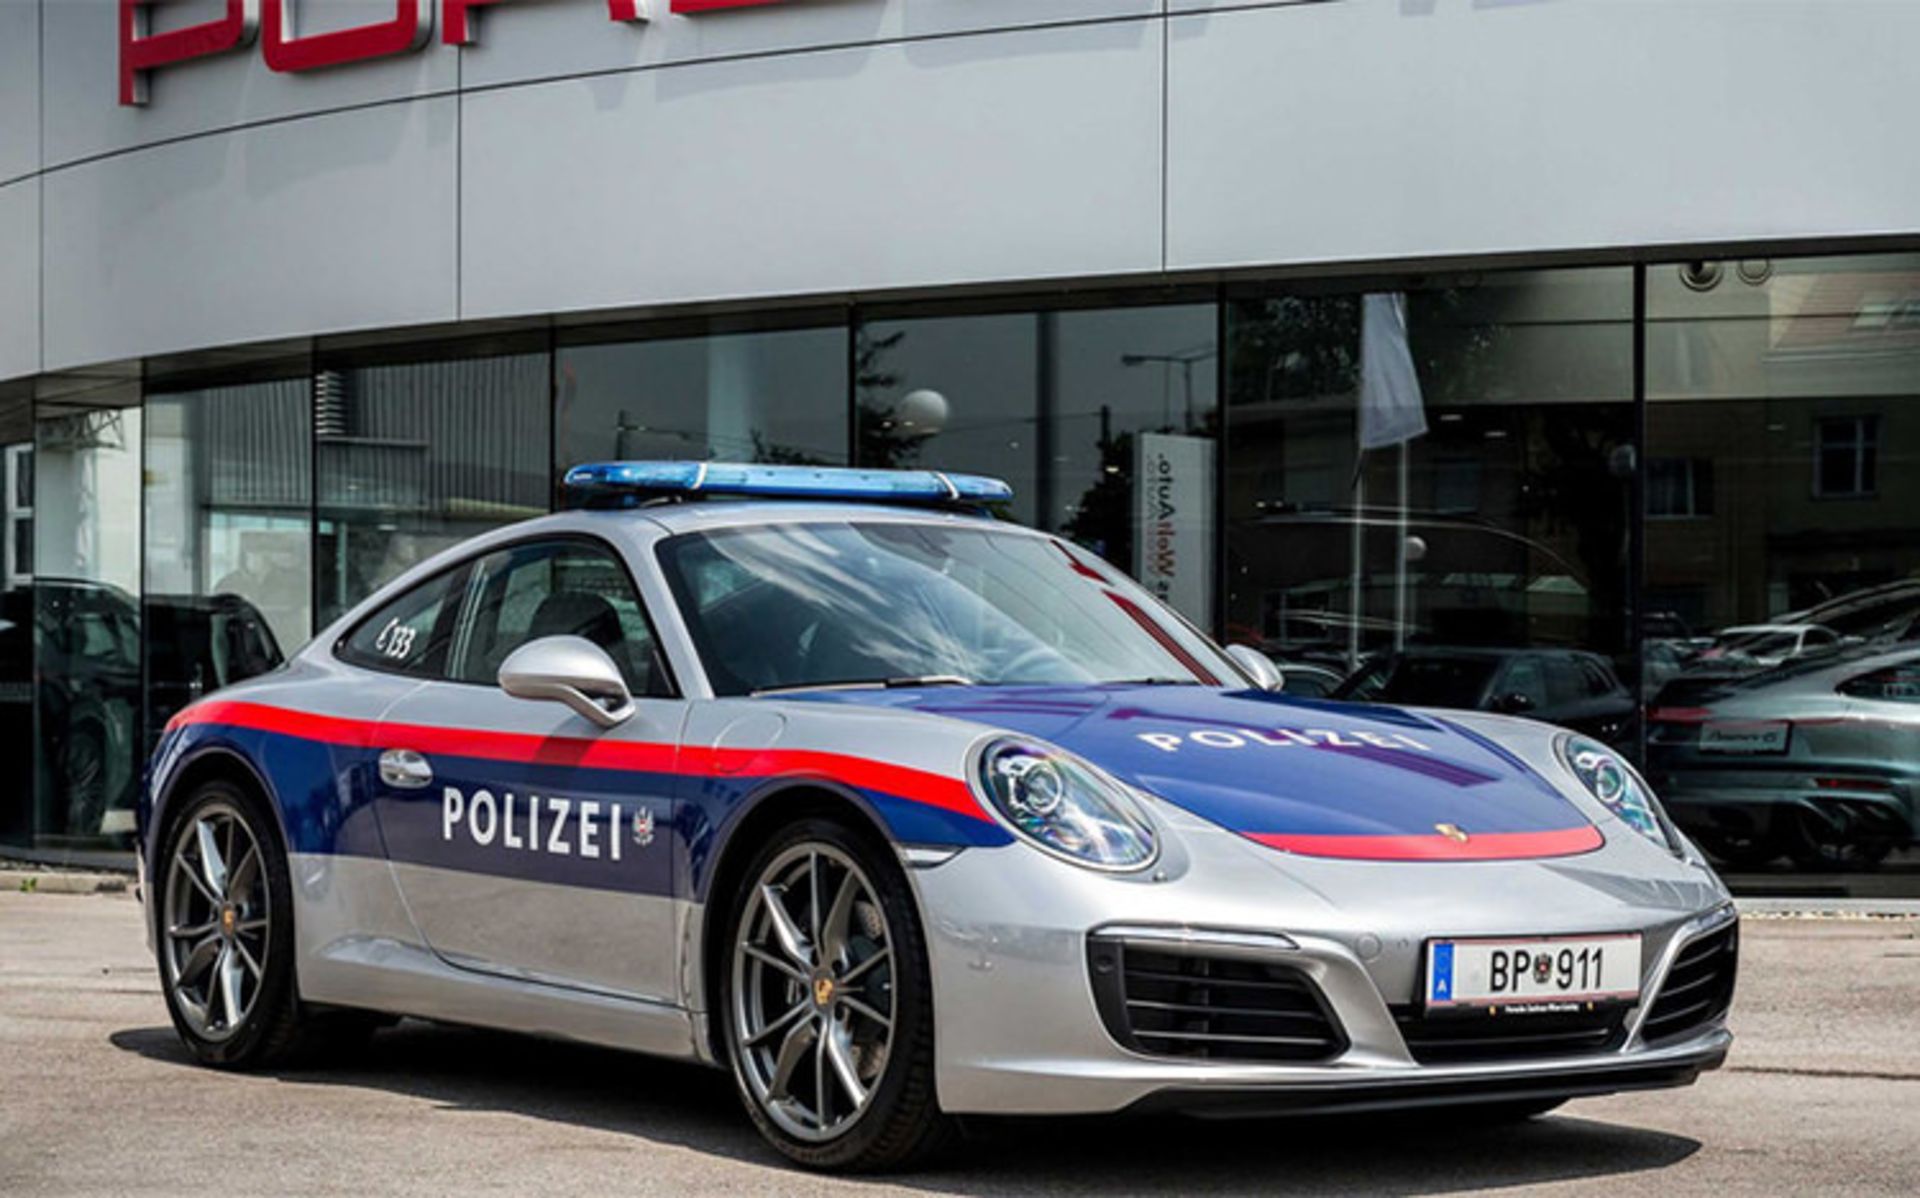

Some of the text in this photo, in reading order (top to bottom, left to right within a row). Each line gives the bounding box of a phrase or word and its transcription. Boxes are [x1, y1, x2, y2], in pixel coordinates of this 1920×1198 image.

[385, 625, 416, 659] 133
[1137, 728, 1431, 752] POLIZEI
[442, 786, 621, 861] POLIZEI
[1436, 978, 1448, 993] A
[1489, 947, 1604, 993] BP 911
